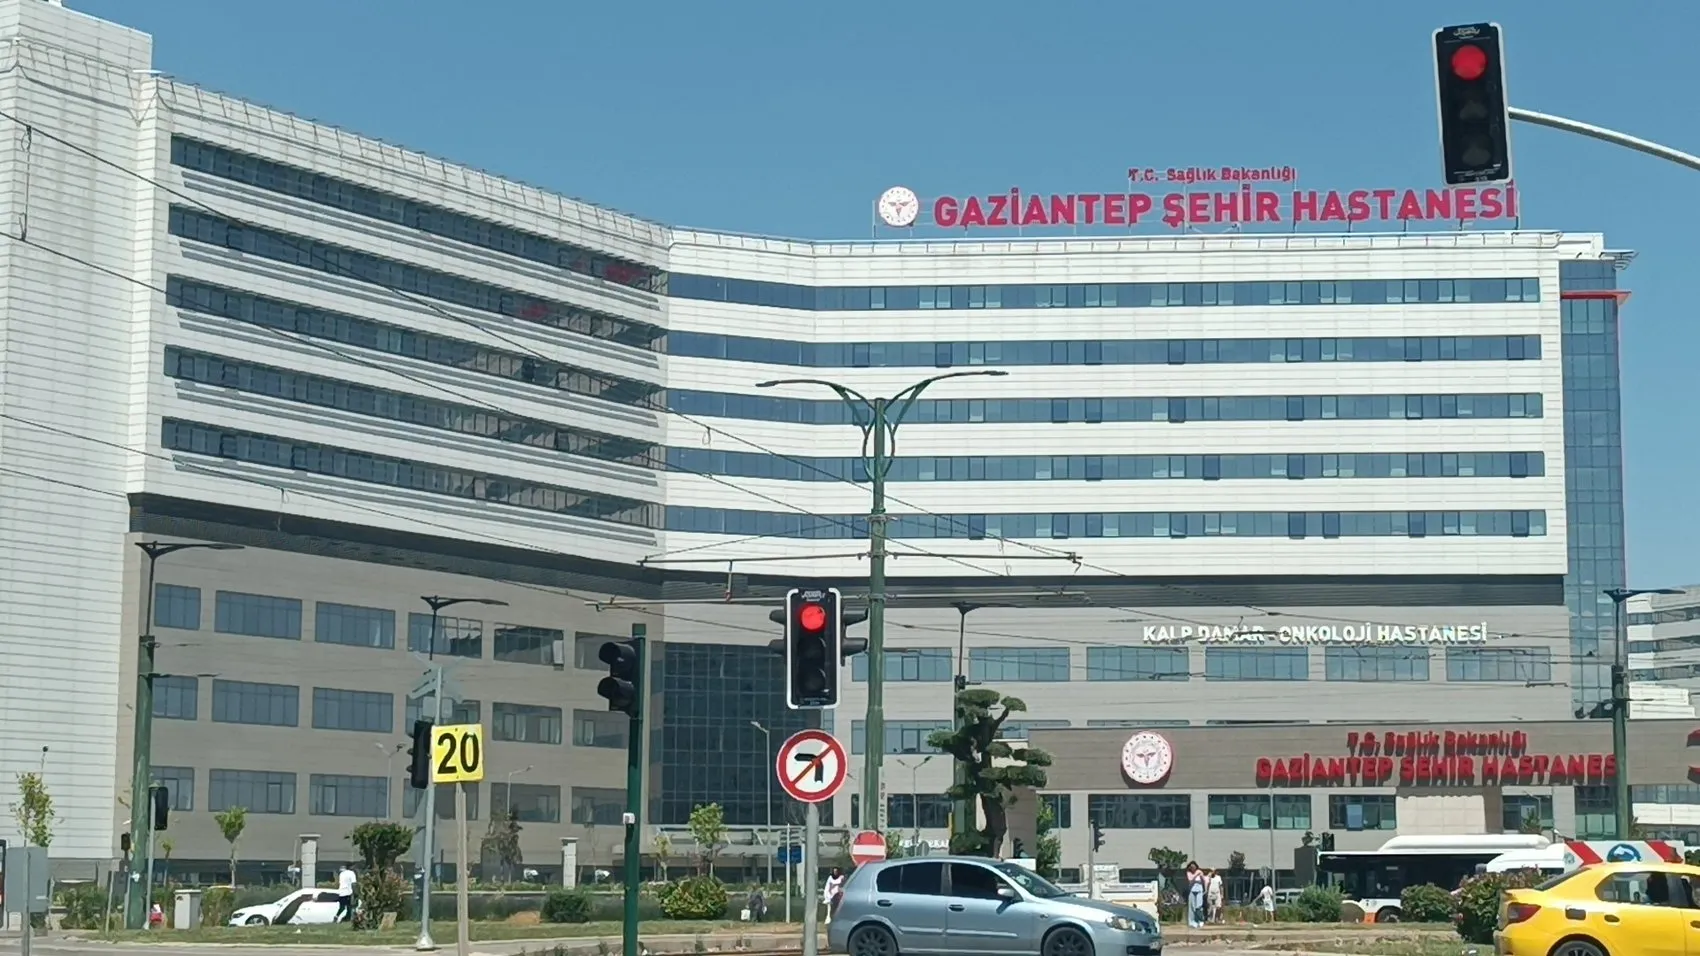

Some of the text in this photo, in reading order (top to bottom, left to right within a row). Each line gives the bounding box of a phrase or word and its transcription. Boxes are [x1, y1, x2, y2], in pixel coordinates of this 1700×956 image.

[1129, 166, 1296, 183] T.C. Sağlık Bakanlığı
[934, 179, 1517, 228] GAZİANTEP ŞEHİR HASTANESİ
[1143, 625, 1193, 642] KALP
[1198, 625, 1265, 642] DAMAR
[1279, 622, 1371, 642] ONKOLOJİ
[1377, 621, 1487, 642] HASTANESİ
[437, 732, 479, 774] 20
[1256, 753, 1393, 783] GAZİANTEP
[1482, 754, 1617, 782] HASTANES
